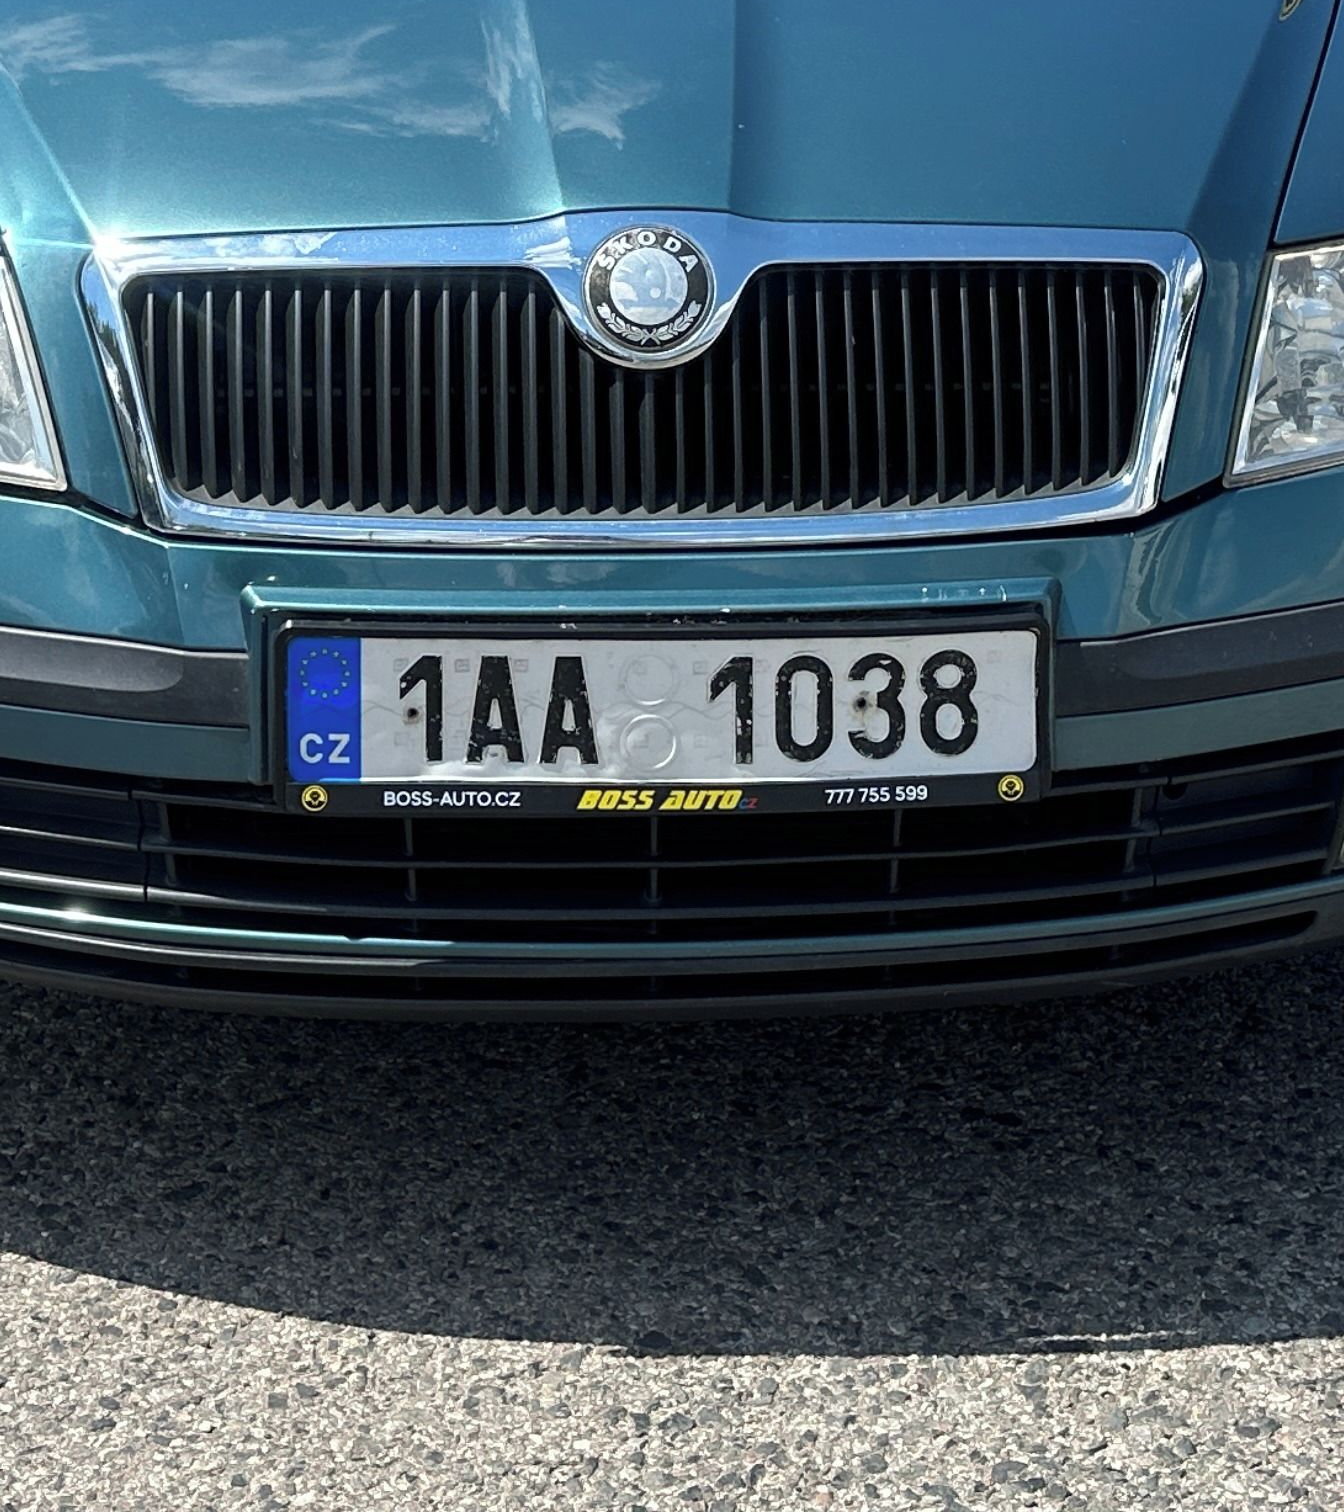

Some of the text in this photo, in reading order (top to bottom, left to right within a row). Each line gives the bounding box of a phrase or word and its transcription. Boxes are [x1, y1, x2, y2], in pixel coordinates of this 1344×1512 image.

[399, 649, 979, 765] 1AA 1038
[299, 733, 351, 764] CZ
[383, 791, 521, 806] BOSS-AUTO.CZ
[576, 790, 655, 810] BOSS
[824, 785, 928, 804] 777 755 599
